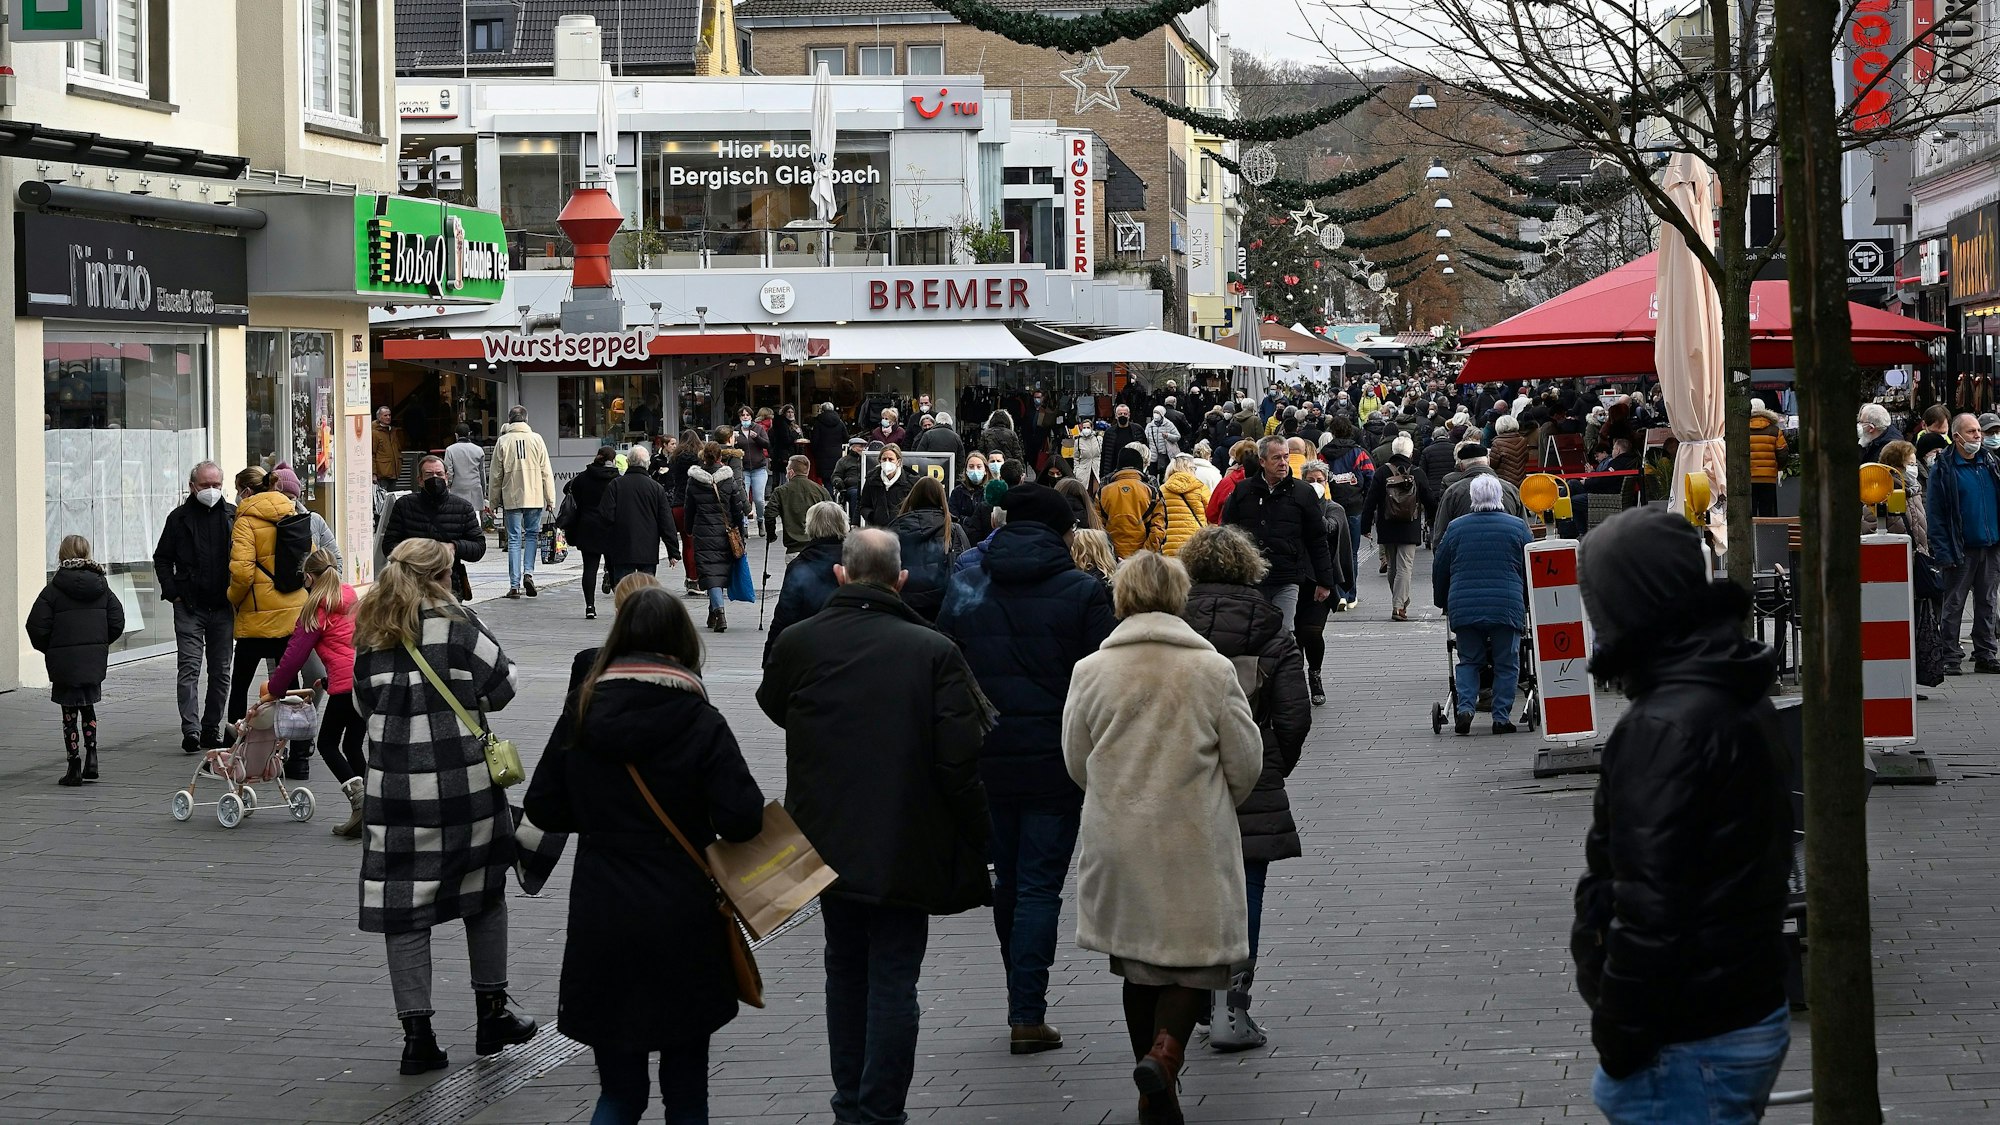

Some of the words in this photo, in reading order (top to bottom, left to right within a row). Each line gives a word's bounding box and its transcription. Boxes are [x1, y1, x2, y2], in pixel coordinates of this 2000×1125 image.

[951, 101, 979, 116] TUI
[717, 140, 762, 159] Hier
[669, 165, 768, 190] Bergisch
[1071, 139, 1089, 273] RÖSELER
[393, 231, 447, 298] BoBoQ
[463, 239, 492, 279] Bubble
[492, 242, 510, 281] Tea
[1191, 228, 1203, 269] WILMS
[764, 286, 791, 294] BREMER
[869, 278, 1031, 310] BREMER
[484, 330, 645, 363] Wurstseppel
